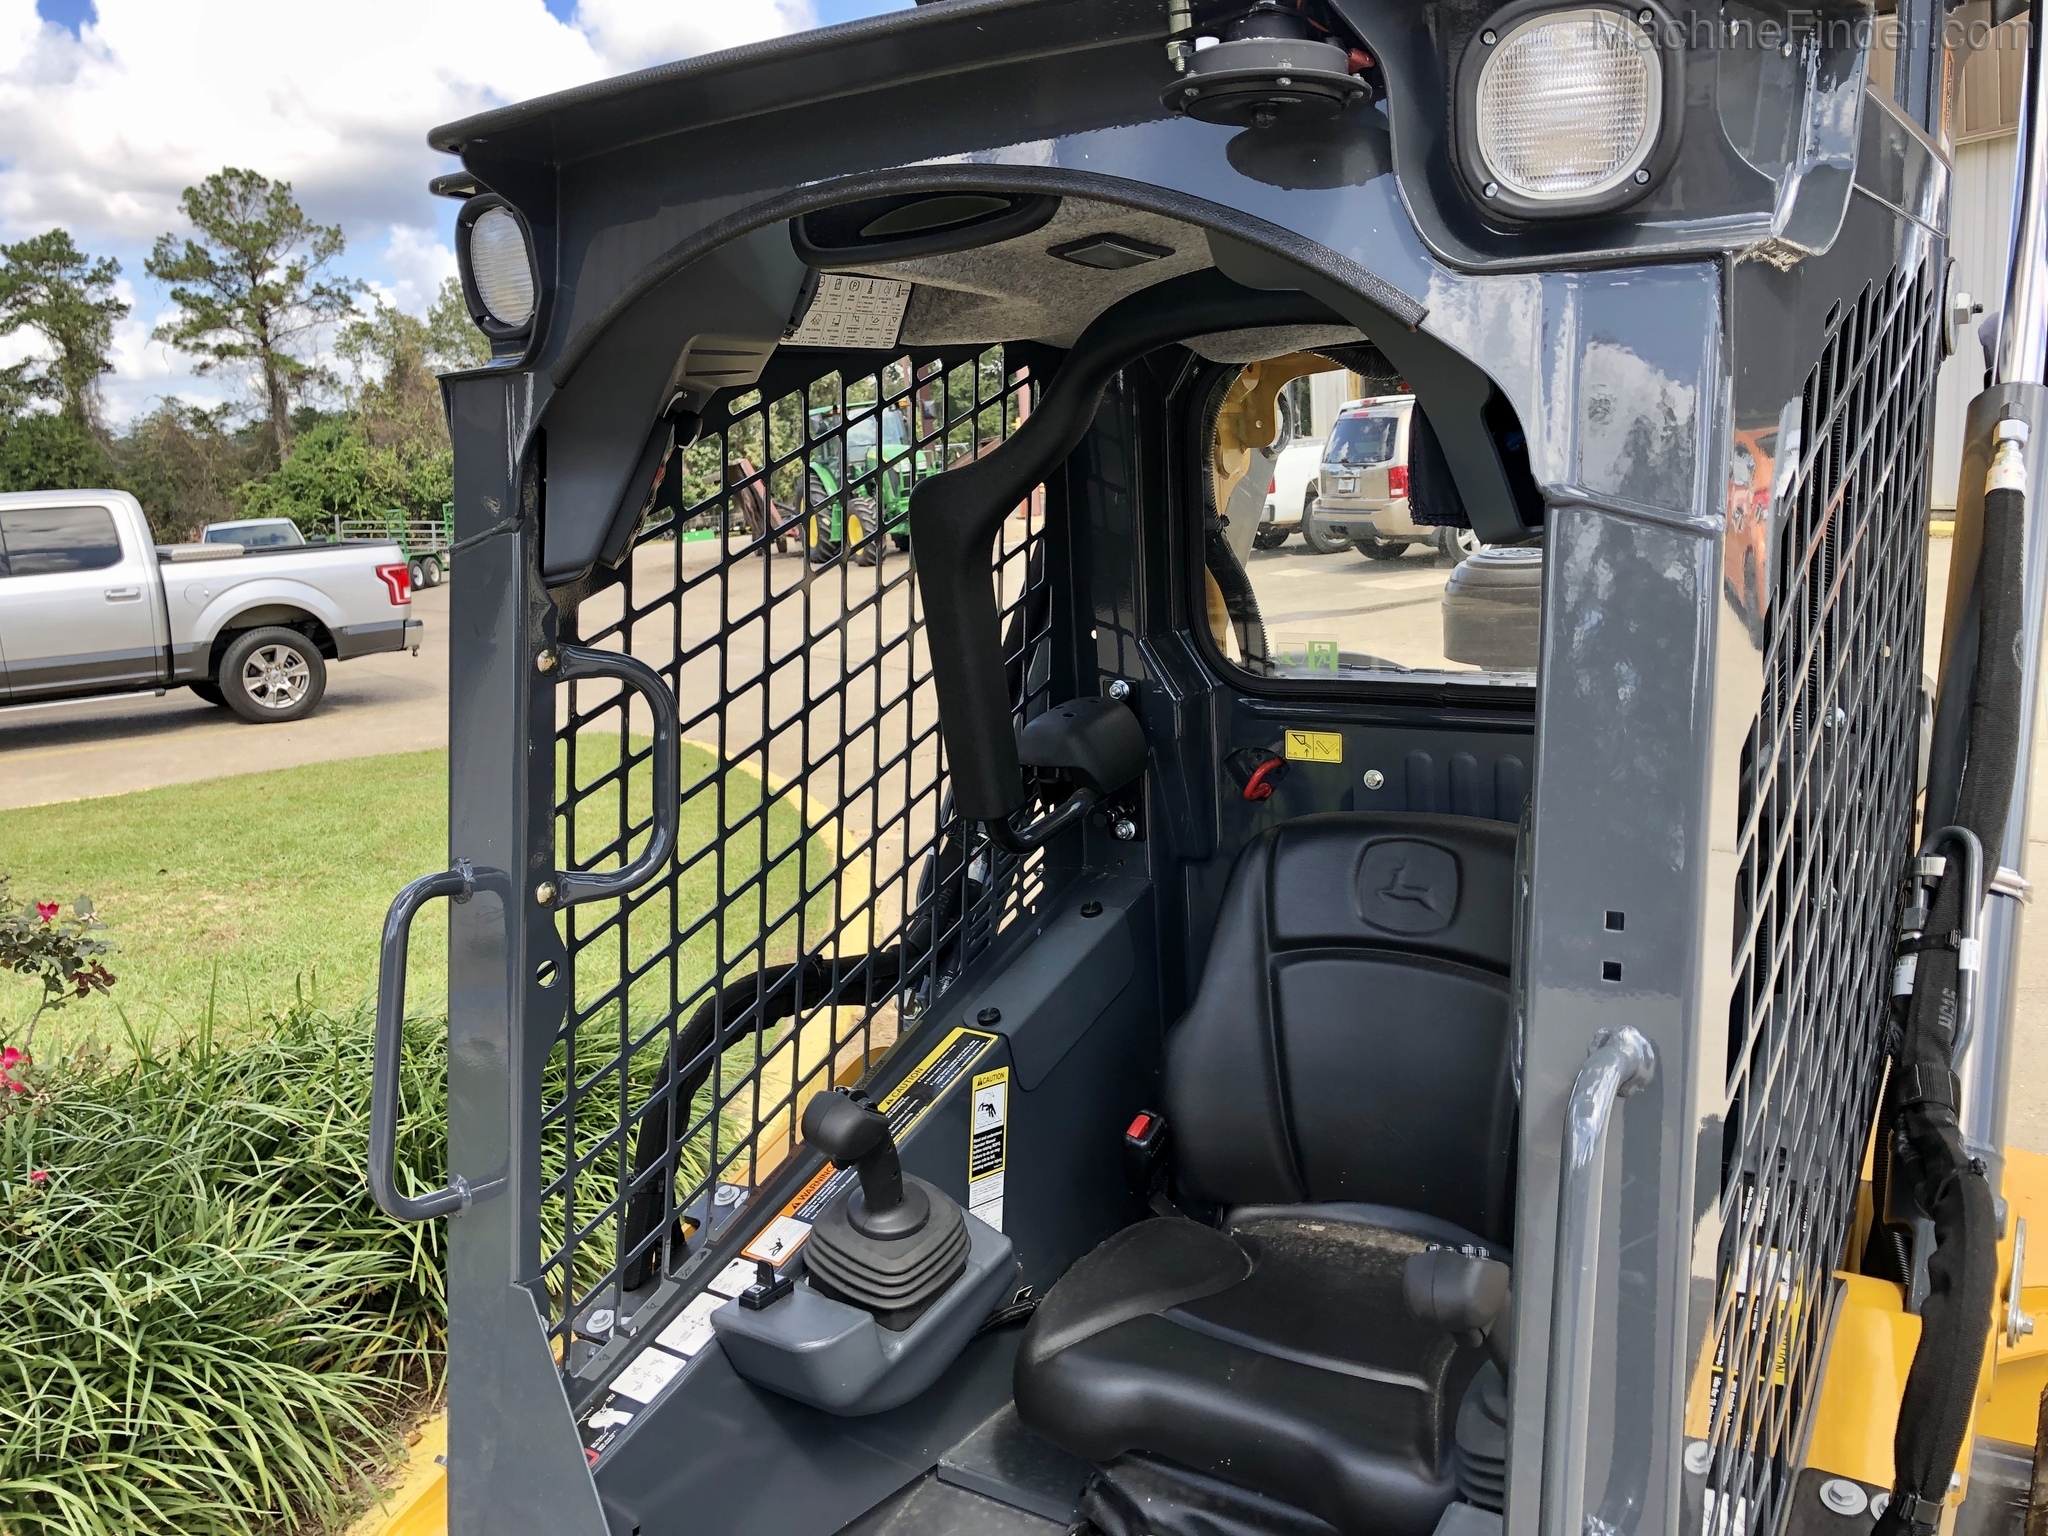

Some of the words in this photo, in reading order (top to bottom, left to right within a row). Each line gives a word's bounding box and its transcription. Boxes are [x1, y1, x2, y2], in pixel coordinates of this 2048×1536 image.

[891, 1068, 924, 1098] CAUTION
[983, 1072, 1005, 1084] CAUTION
[798, 1166, 834, 1201] WARNING
